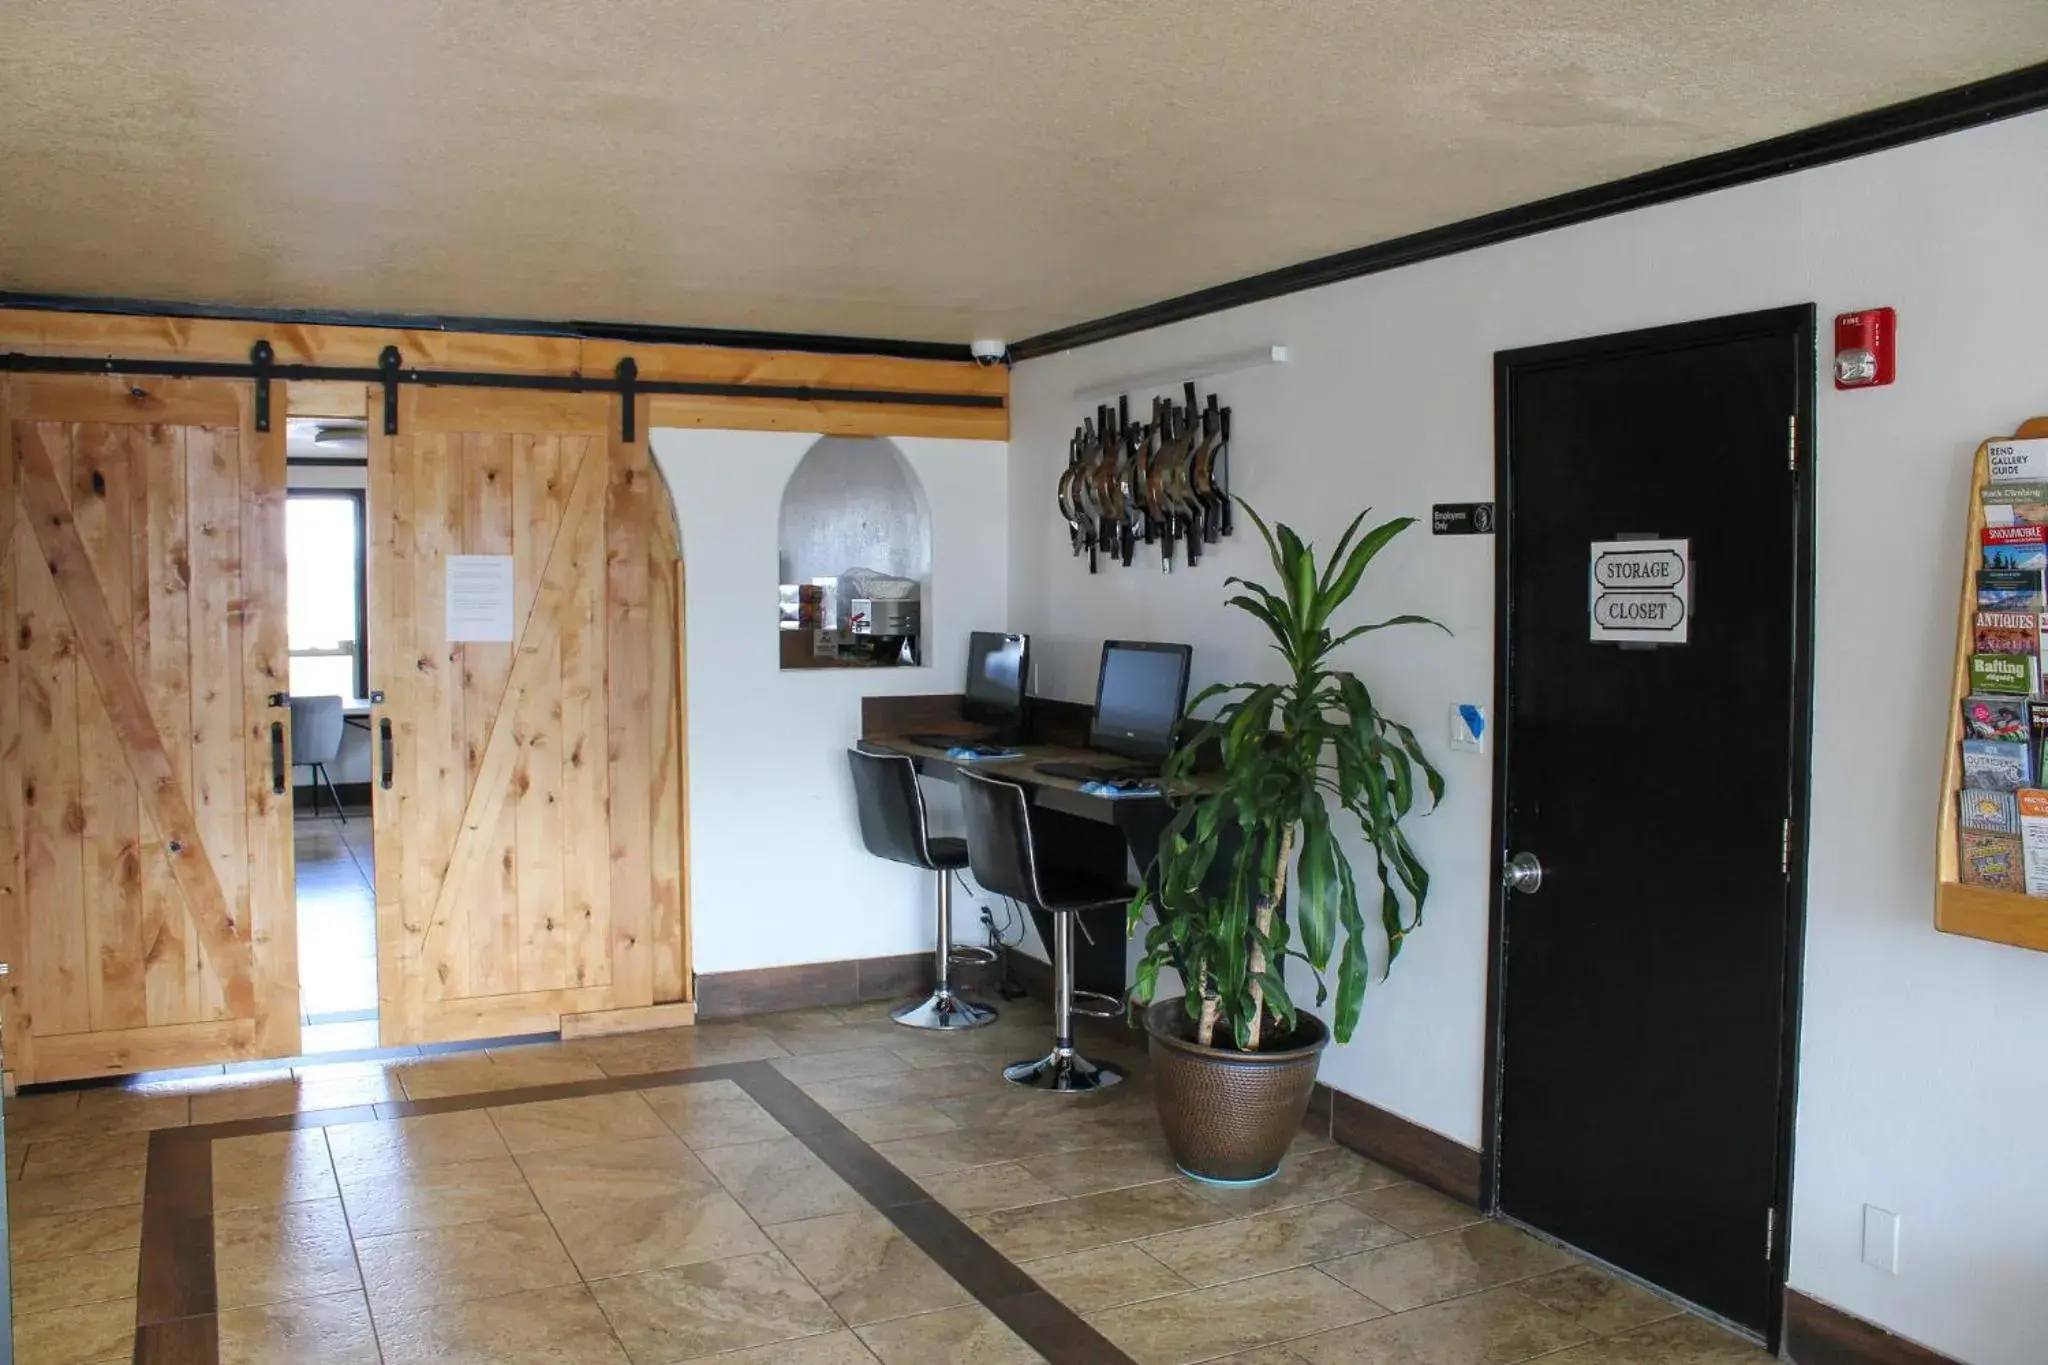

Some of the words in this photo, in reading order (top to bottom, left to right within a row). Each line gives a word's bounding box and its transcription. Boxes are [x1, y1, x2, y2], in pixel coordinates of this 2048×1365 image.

[1991, 455, 2029, 465] GALLERY
[1992, 466, 2019, 475] GUIDE
[1988, 526, 2042, 539] SNOWMOBILE
[1607, 561, 1669, 579] STORAGE
[1609, 602, 1668, 620] CLOSET
[1976, 612, 2034, 629] ANTIQUES
[1974, 659, 2024, 678] Rafting
